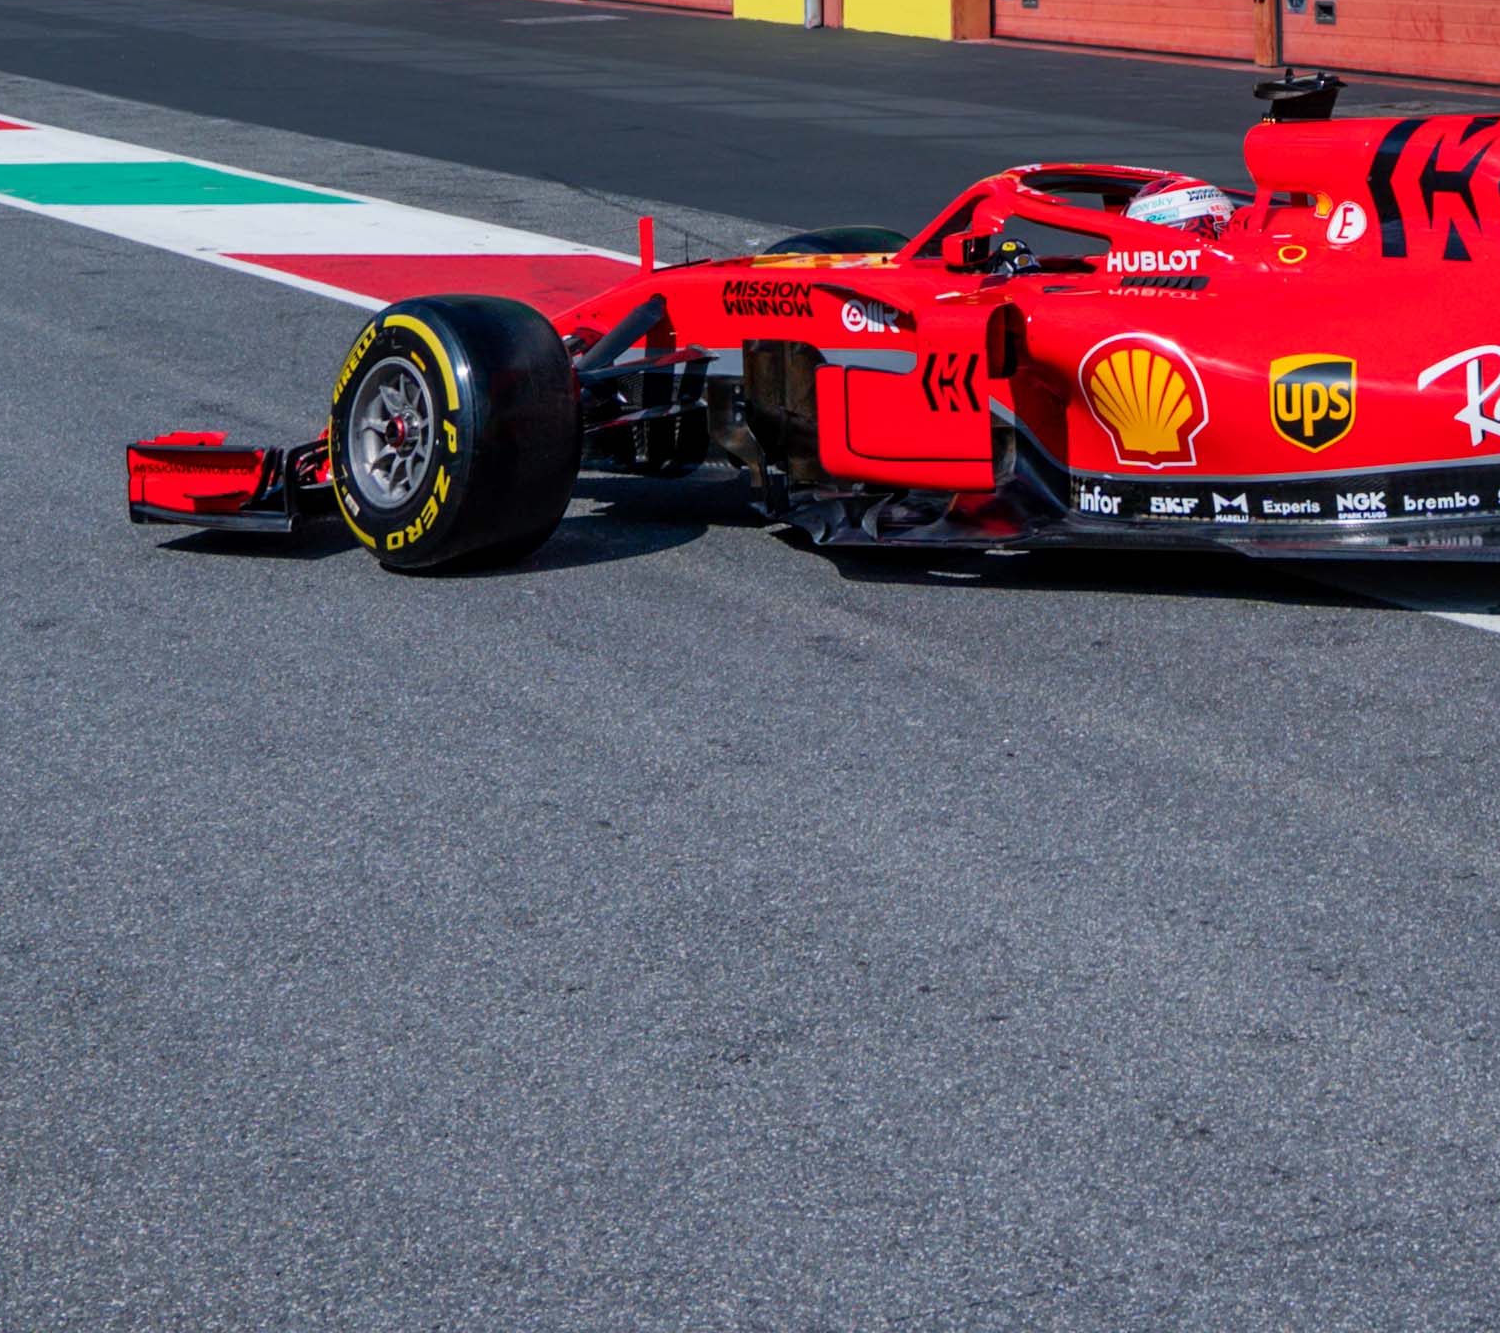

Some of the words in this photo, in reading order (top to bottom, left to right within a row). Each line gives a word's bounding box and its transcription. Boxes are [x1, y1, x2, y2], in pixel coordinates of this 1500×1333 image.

[1341, 207, 1354, 239] E
[1107, 250, 1201, 273] HUBLOT
[722, 281, 812, 298] MISSION
[723, 298, 814, 317] WINNOW
[332, 321, 377, 405] PIRELLI
[1276, 381, 1351, 437] ups
[443, 420, 458, 454] P
[386, 465, 451, 551] ZERO
[1079, 485, 1122, 515] infor
[1150, 496, 1200, 514] SKF
[1262, 499, 1321, 516] Experis
[1336, 491, 1387, 511] NGK
[1403, 492, 1480, 511] brembo
[1215, 514, 1249, 524] MARELLI
